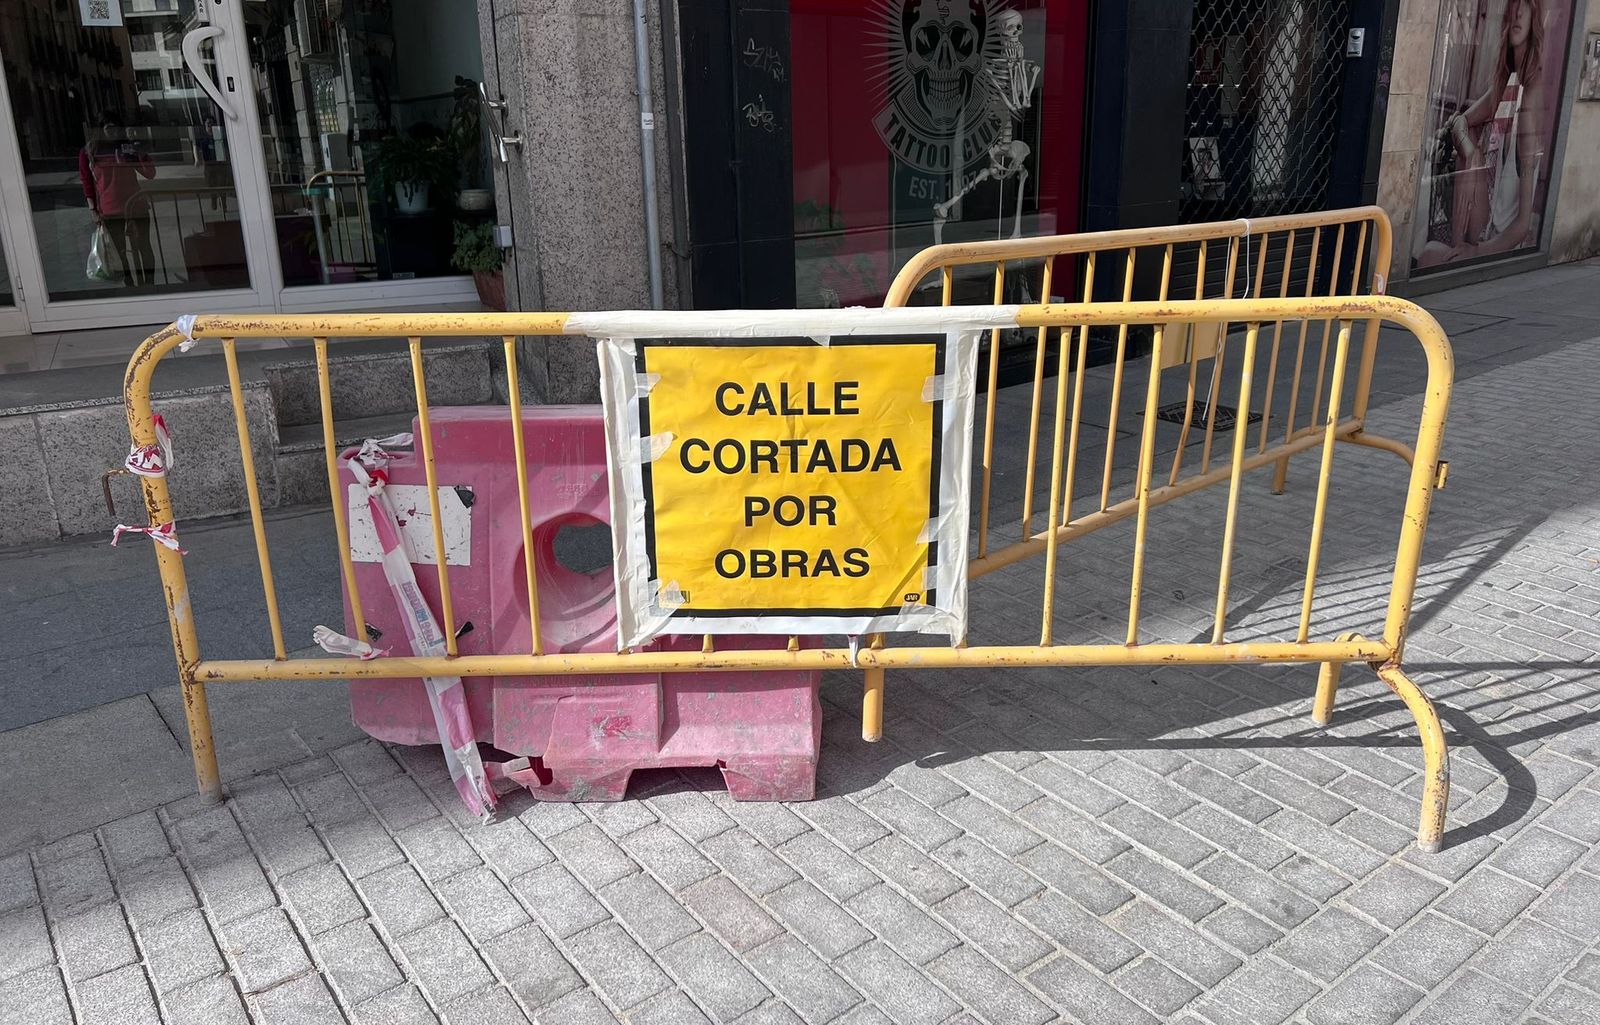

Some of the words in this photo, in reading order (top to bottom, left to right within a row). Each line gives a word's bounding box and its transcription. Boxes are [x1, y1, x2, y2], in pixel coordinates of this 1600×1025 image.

[882, 113, 950, 169] TATTOO
[908, 176, 939, 200] EST.
[715, 381, 860, 417] CALLE
[679, 437, 902, 475] CORTADA
[744, 495, 837, 528] POR
[714, 547, 870, 580] OBRAS
